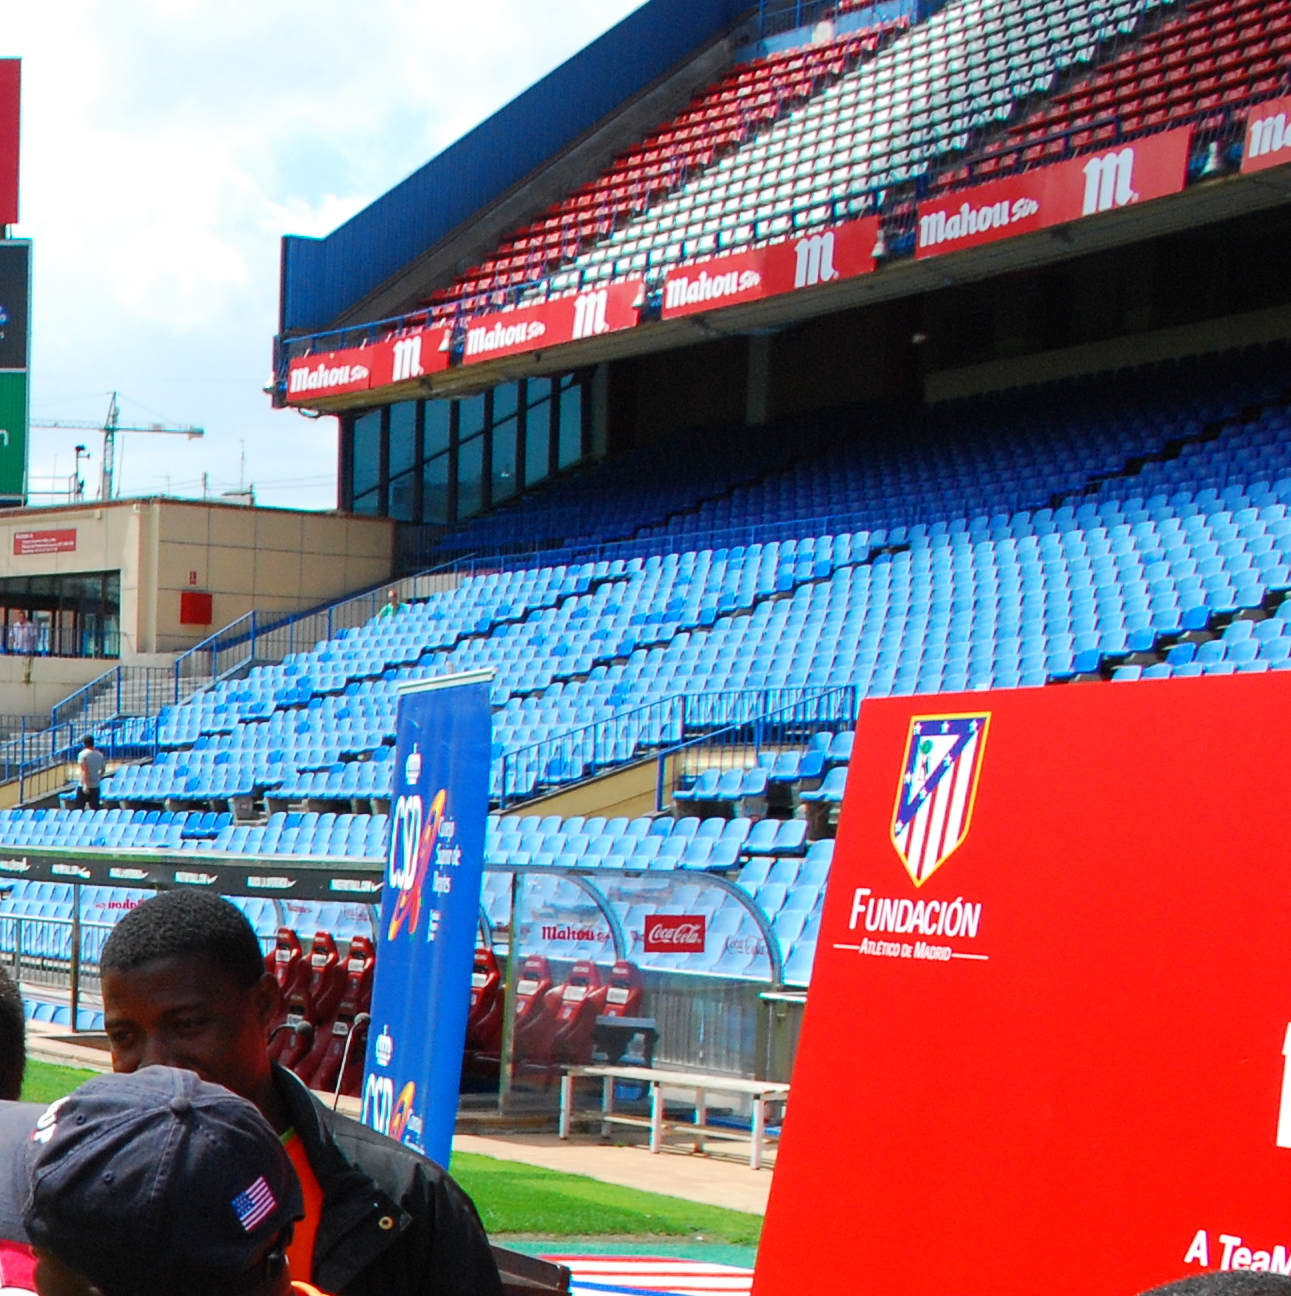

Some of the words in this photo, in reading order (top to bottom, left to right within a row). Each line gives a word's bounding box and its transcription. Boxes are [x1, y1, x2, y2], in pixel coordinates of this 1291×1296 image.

[920, 203, 1009, 248] Mahou
[667, 272, 738, 309] Mahou
[467, 324, 527, 354] Mahou
[291, 365, 350, 393] Mahou
[848, 887, 982, 938] FUNDACIÓN
[648, 922, 702, 945] Coca-Cola
[1184, 1230, 1209, 1267] A
